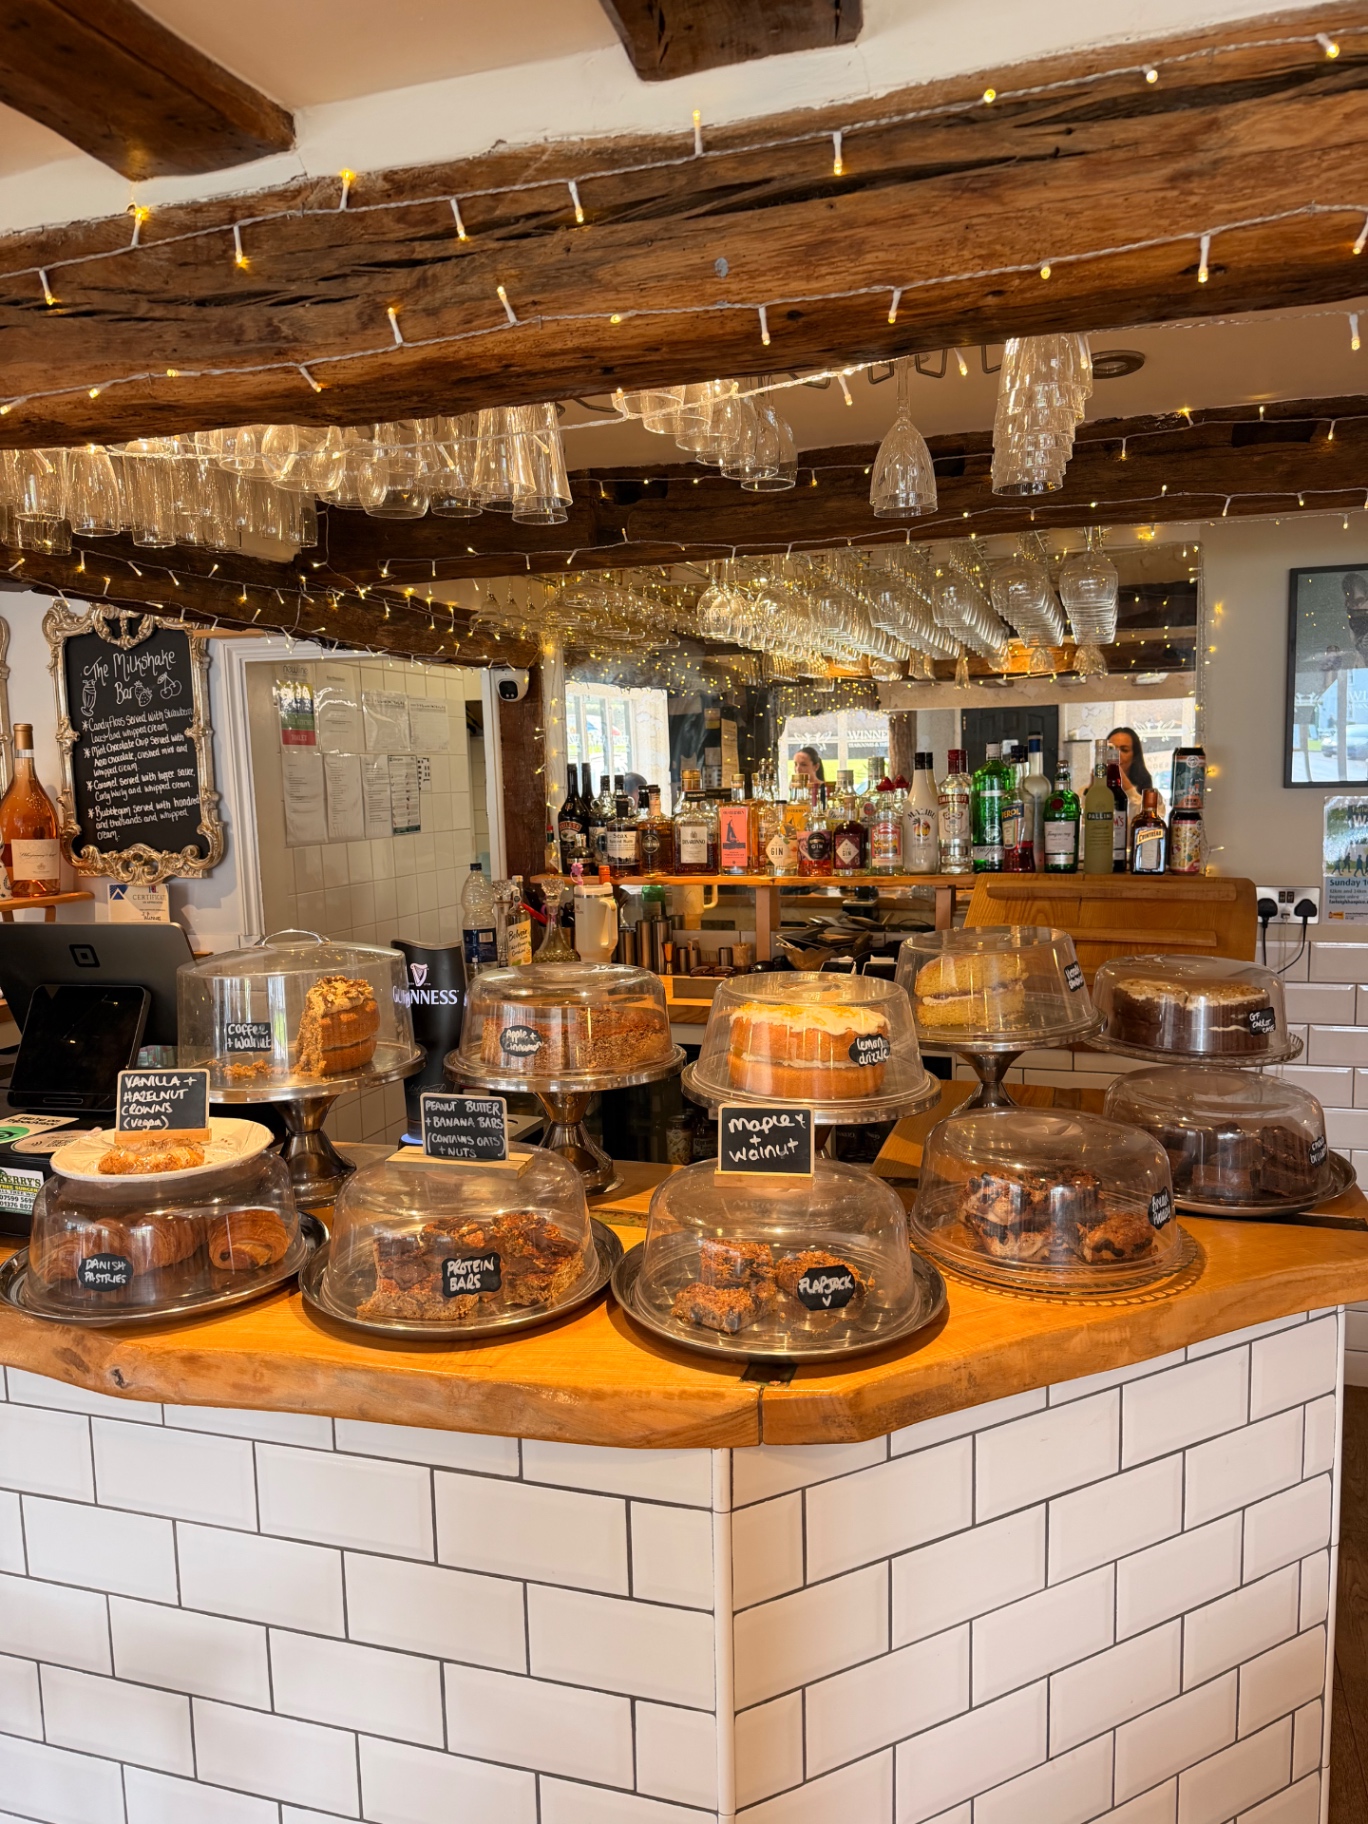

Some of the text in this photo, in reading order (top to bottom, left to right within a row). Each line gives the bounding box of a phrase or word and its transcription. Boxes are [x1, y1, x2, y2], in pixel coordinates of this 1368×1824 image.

[83, 649, 176, 686] The Milkshake
[114, 681, 134, 704] Bar
[770, 847, 783, 856] GIN
[1330, 878, 1361, 887] Sunday
[506, 1029, 528, 1043] Apple
[125, 1075, 198, 1089] VANILLA +
[123, 1088, 189, 1103] HAZELNUT
[121, 1102, 173, 1116] CROWNS
[425, 1100, 457, 1112] PEANUT
[433, 1116, 475, 1128] BANANA
[476, 1116, 504, 1129] BARS
[749, 1134, 761, 1147] +
[85, 1258, 126, 1271] DANISH
[447, 1256, 495, 1277] PROTEIN
[84, 1271, 127, 1284] PASTRIES
[449, 1273, 481, 1292] BARS
[798, 1275, 854, 1295] FLAPJACK
